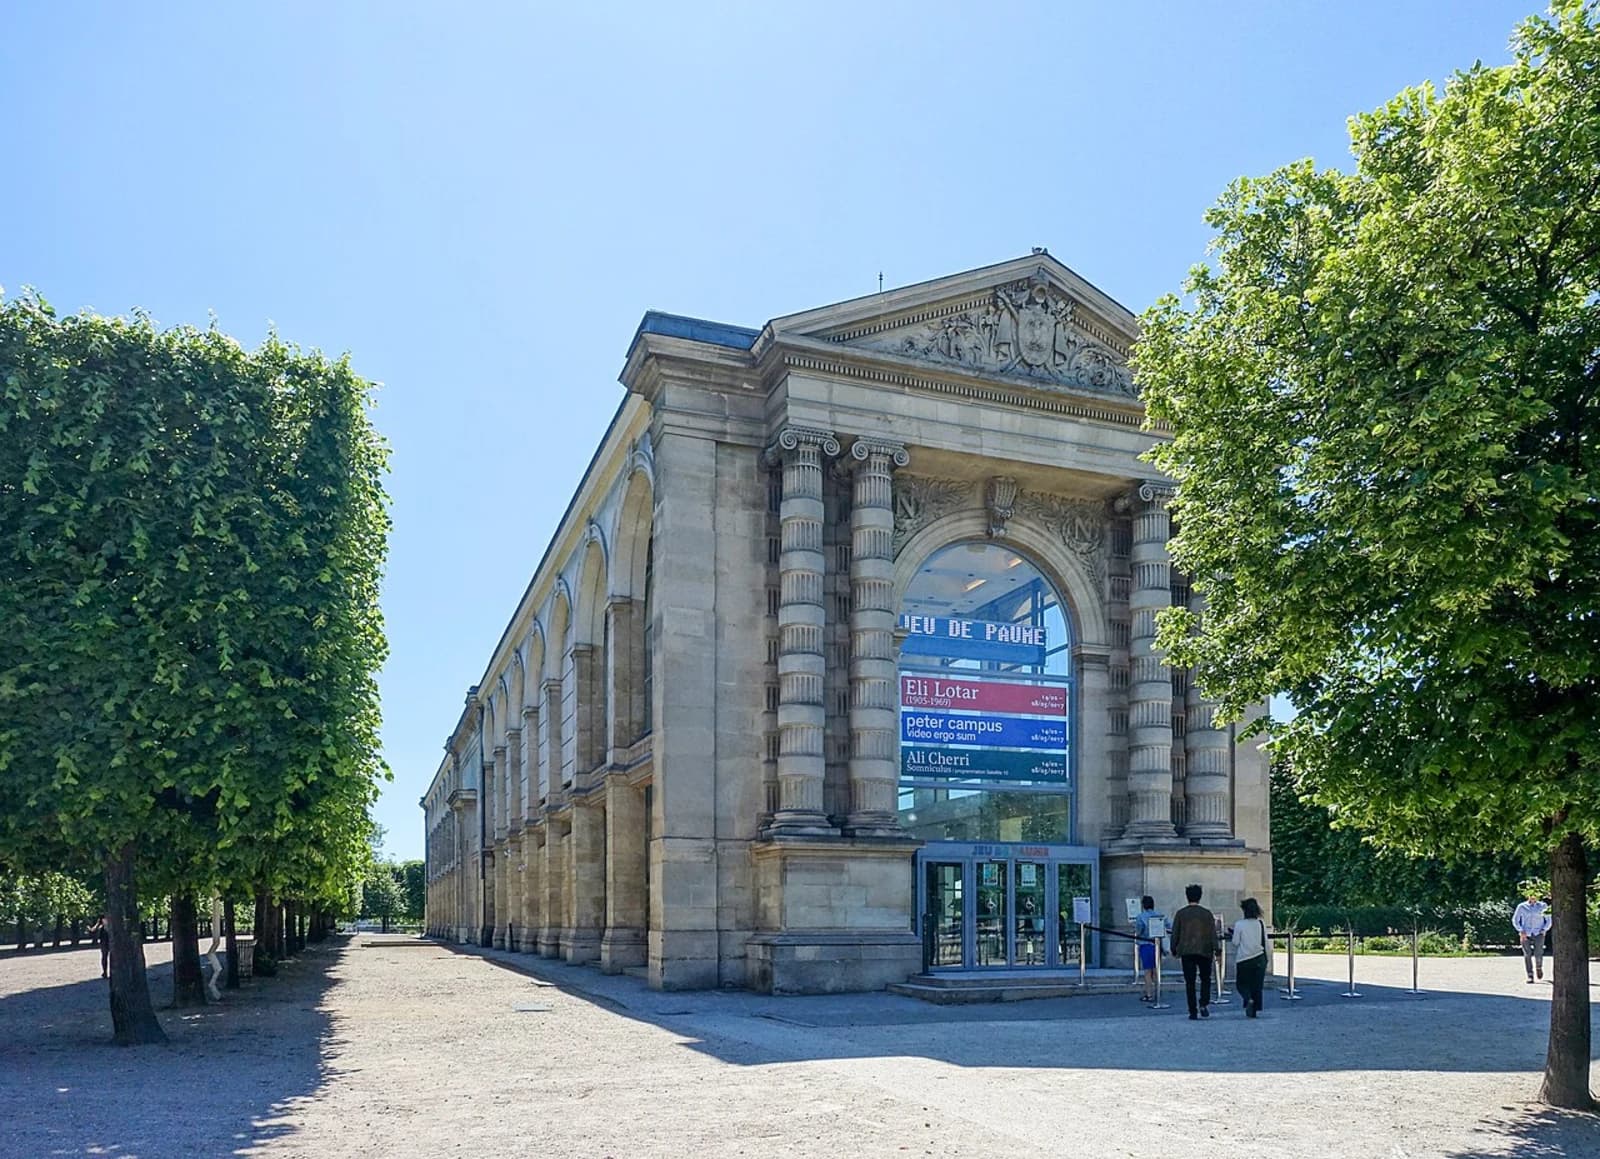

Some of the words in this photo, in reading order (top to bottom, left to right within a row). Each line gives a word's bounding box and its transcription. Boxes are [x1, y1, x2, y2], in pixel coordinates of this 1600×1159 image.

[1074, 515, 1093, 540] N
[948, 619, 973, 638] DE
[985, 623, 1045, 646] PAUME
[906, 679, 928, 696] Eli
[934, 681, 979, 700] Lotar
[905, 695, 951, 708] (1905-1969)
[906, 714, 945, 730] peter
[948, 719, 1003, 734] campus
[906, 727, 932, 739] video
[933, 731, 955, 742] ergo
[956, 733, 976, 741] sum
[906, 750, 925, 764] Ali
[928, 752, 970, 766] Cherri
[906, 763, 952, 773] Somniculus
